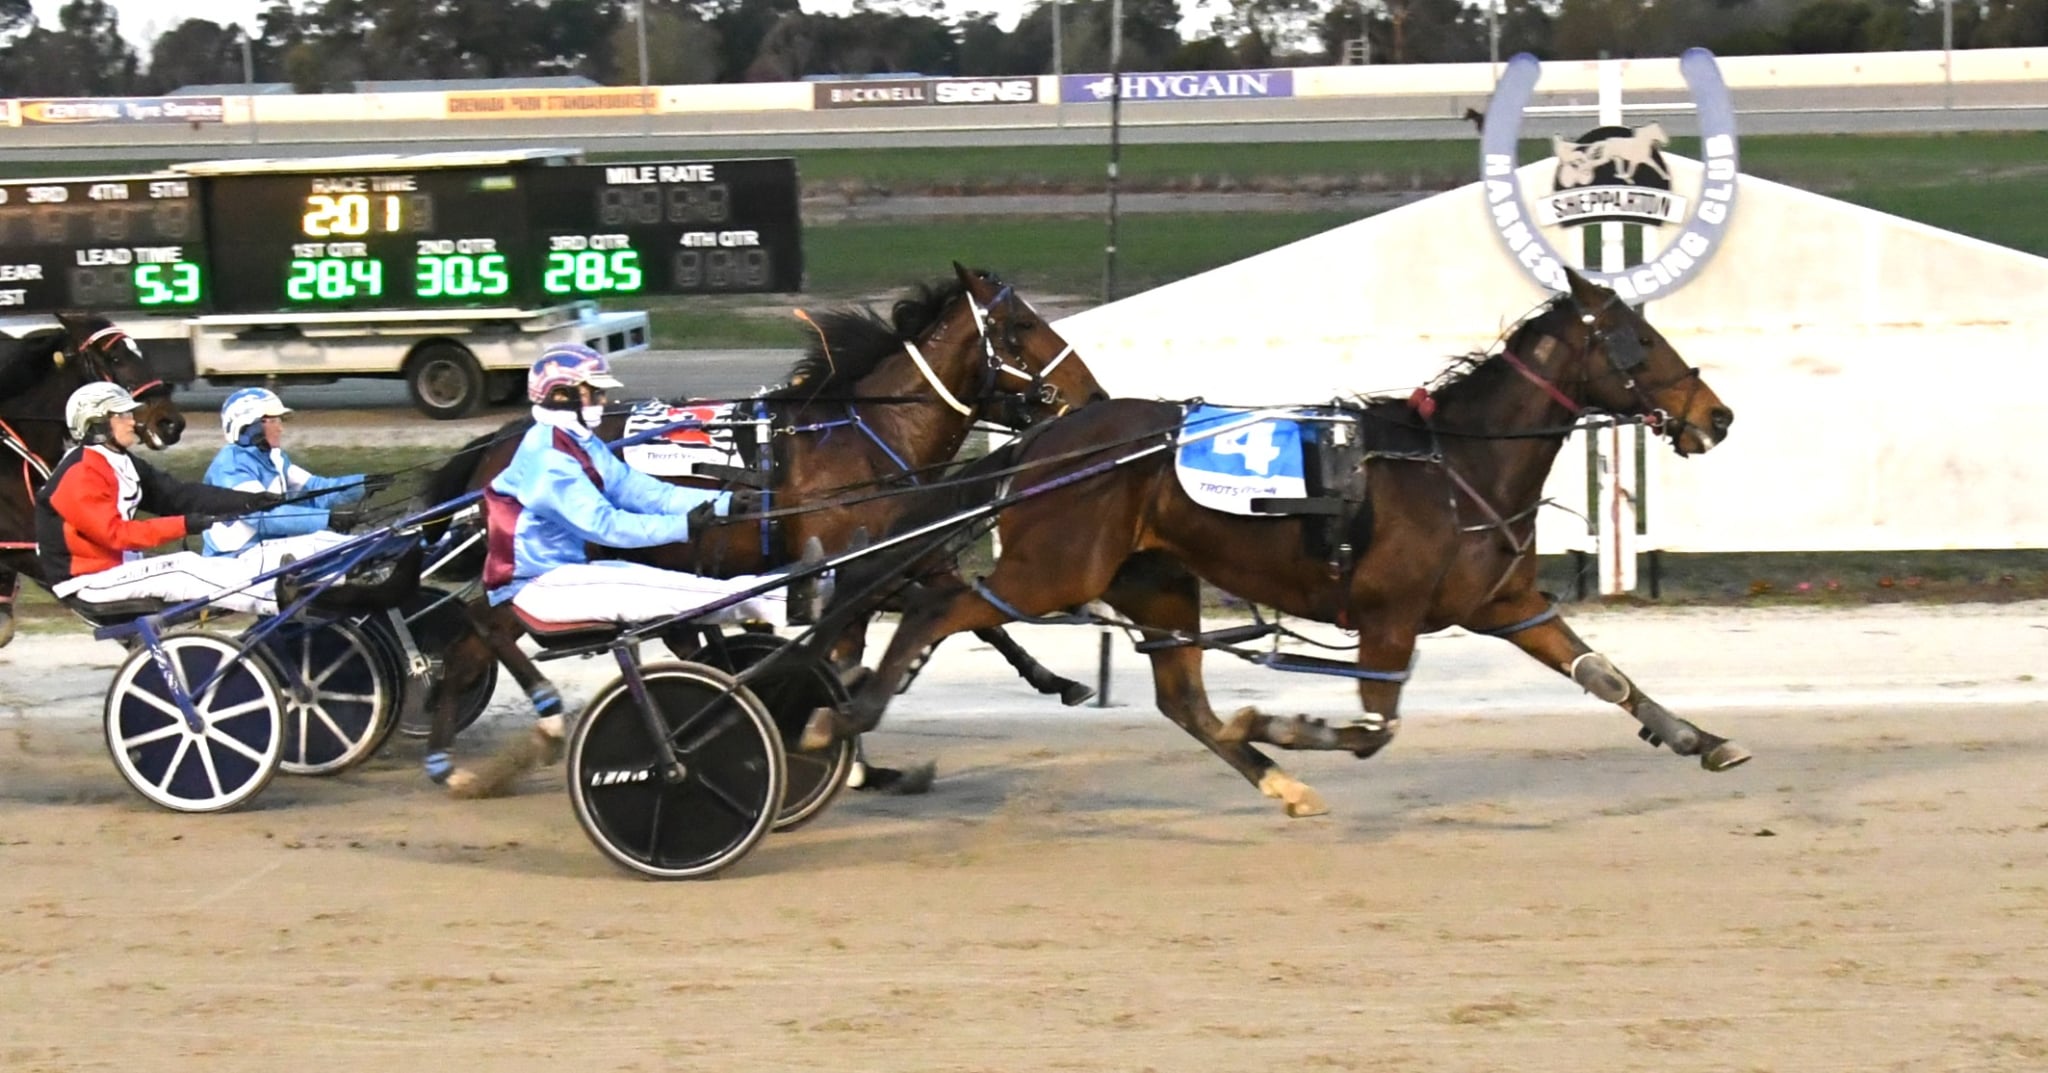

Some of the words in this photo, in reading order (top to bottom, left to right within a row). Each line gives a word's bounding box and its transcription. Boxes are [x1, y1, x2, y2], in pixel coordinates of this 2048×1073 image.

[831, 87, 924, 103] BICKNELL
[936, 80, 1033, 103] SIGNS
[1121, 74, 1273, 98] HYGAIN
[312, 177, 368, 193] RACE
[372, 175, 418, 191] TIME
[606, 167, 656, 184] MILE
[659, 165, 715, 182] RATE
[1697, 134, 1735, 225] CLUB
[26, 186, 68, 203] 3RD
[89, 184, 129, 200] 4TH
[150, 181, 189, 198] 5TH
[1552, 191, 1671, 218] SHEPPARTON
[417, 240, 455, 255] 2ND
[457, 238, 497, 253] QTR
[550, 235, 587, 251] 3RD
[589, 234, 630, 249] QTR
[680, 232, 717, 247] 4TH
[719, 231, 760, 246] QTR
[76, 248, 132, 266] LEAD
[133, 246, 184, 263] TIME
[292, 243, 326, 258] 1ST
[327, 242, 367, 257] QTR
[288, 259, 382, 300] 28.4
[416, 255, 509, 297] 30.5
[545, 251, 642, 293] 28.5
[134, 263, 200, 304] 5.3
[1213, 421, 1281, 476] 4
